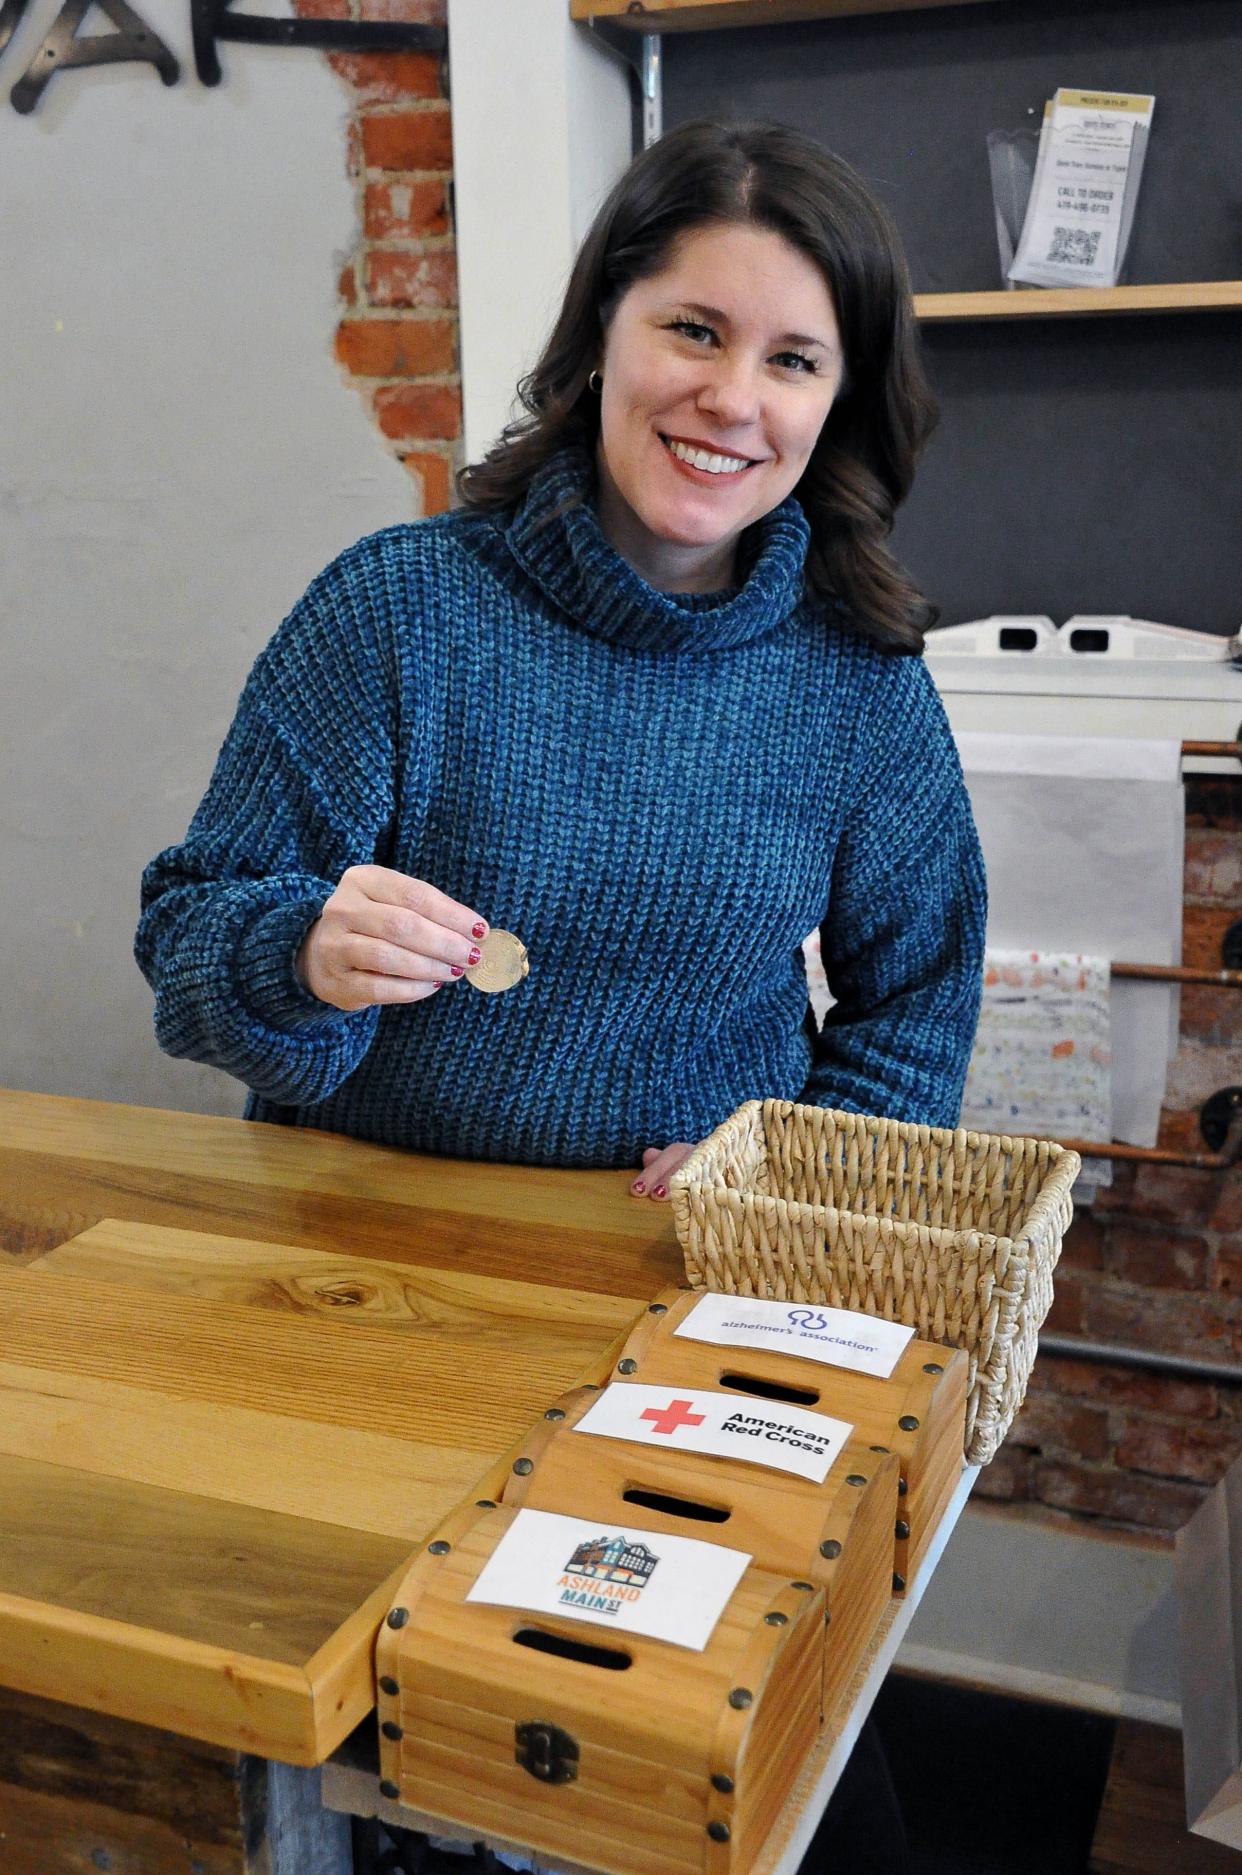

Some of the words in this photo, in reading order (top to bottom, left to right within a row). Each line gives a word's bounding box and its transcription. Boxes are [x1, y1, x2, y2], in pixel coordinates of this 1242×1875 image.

[1057, 186, 1075, 198] CALL
[1078, 188, 1087, 198] TO
[721, 1320, 793, 1335] alzheimer's
[721, 1422, 762, 1437] Red
[765, 1431, 824, 1456] Cross
[728, 1412, 830, 1446] American
[557, 1574, 641, 1601] ASHLAND
[560, 1589, 608, 1609] MAIN
